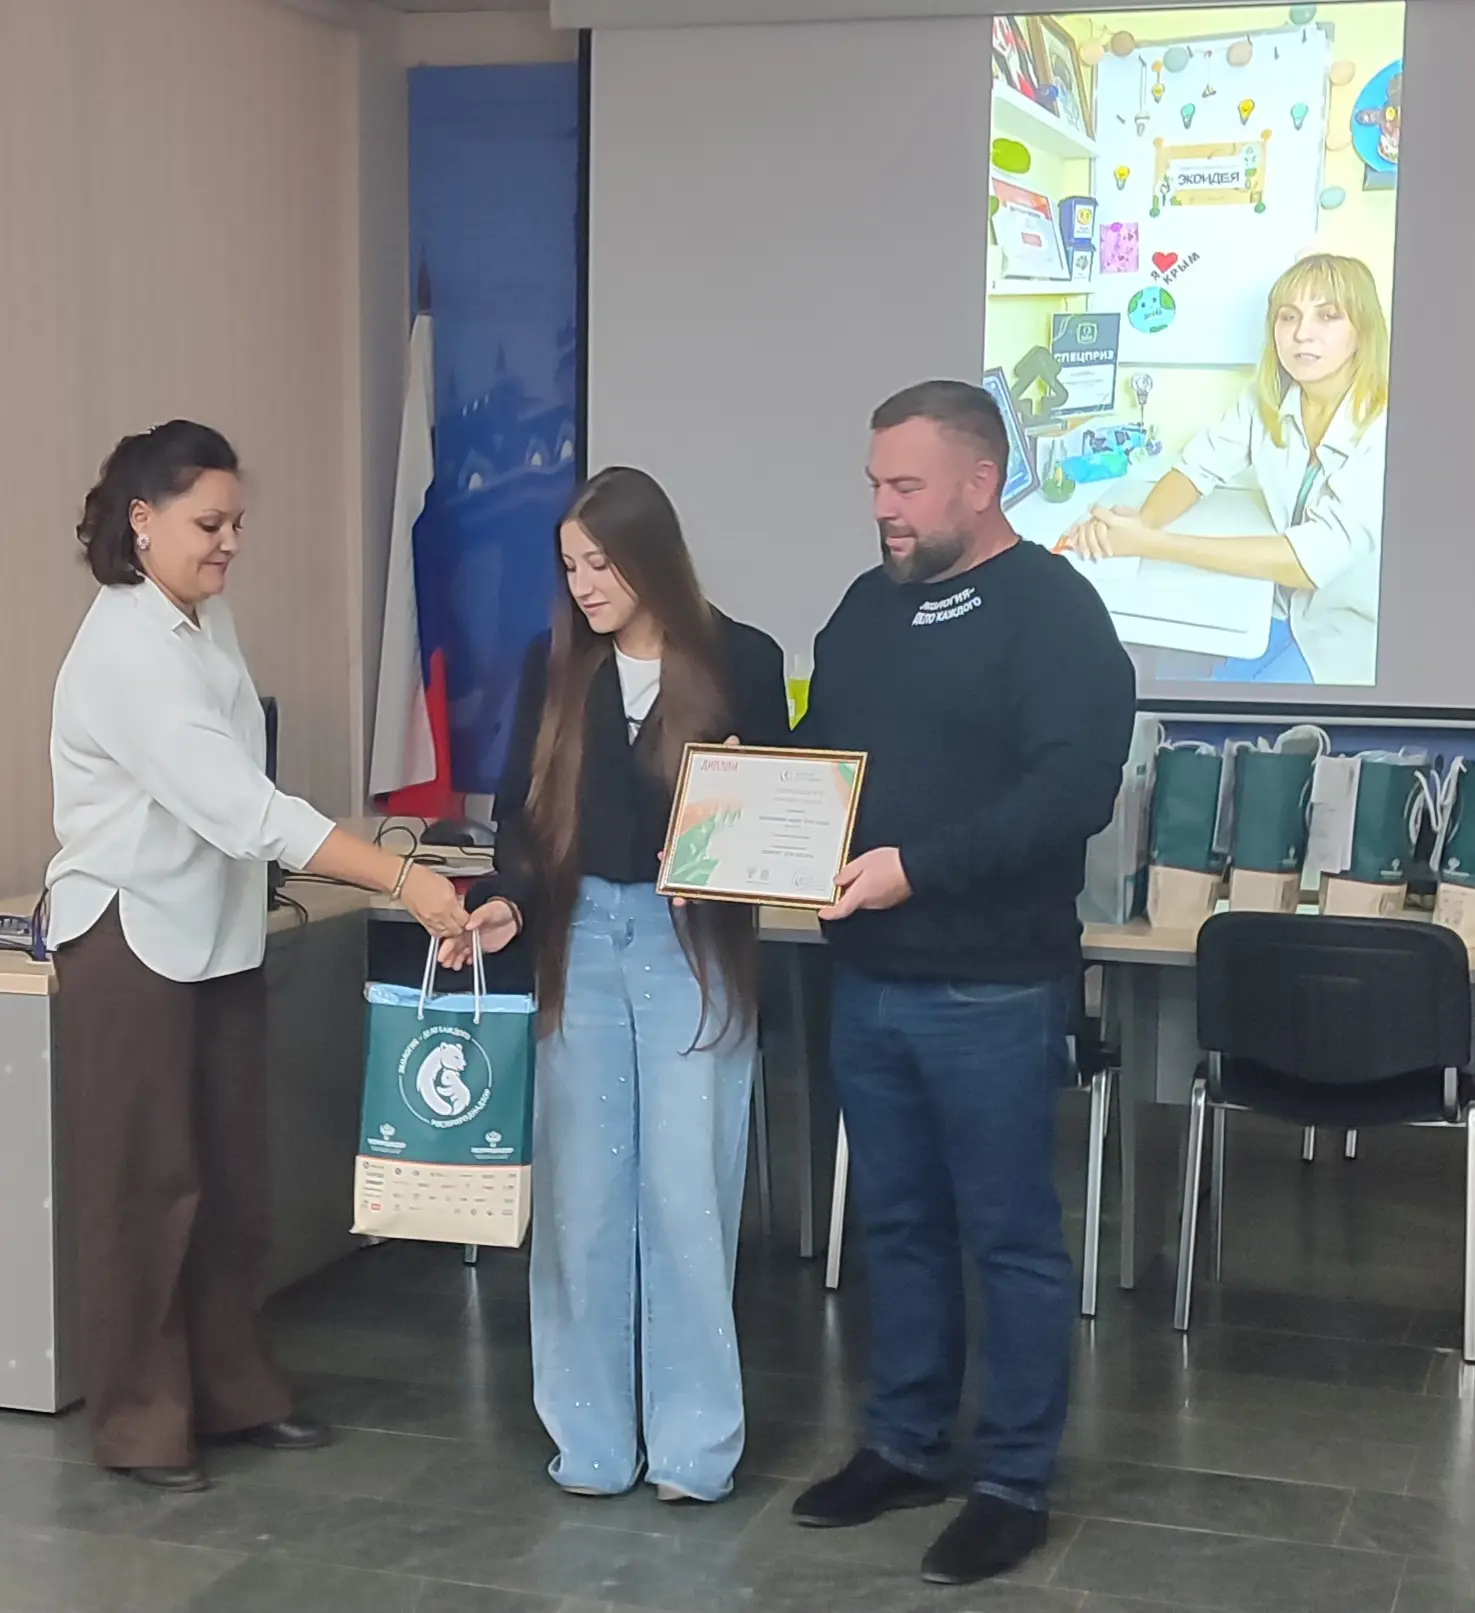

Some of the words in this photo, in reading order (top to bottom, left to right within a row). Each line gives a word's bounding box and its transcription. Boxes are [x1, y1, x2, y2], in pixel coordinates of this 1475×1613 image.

[1178, 171, 1240, 186] ЭКОИДЕЯ
[1150, 270, 1161, 281] Я
[1162, 251, 1201, 285] КРЫМ
[936, 596, 982, 622] КАЖДОГО
